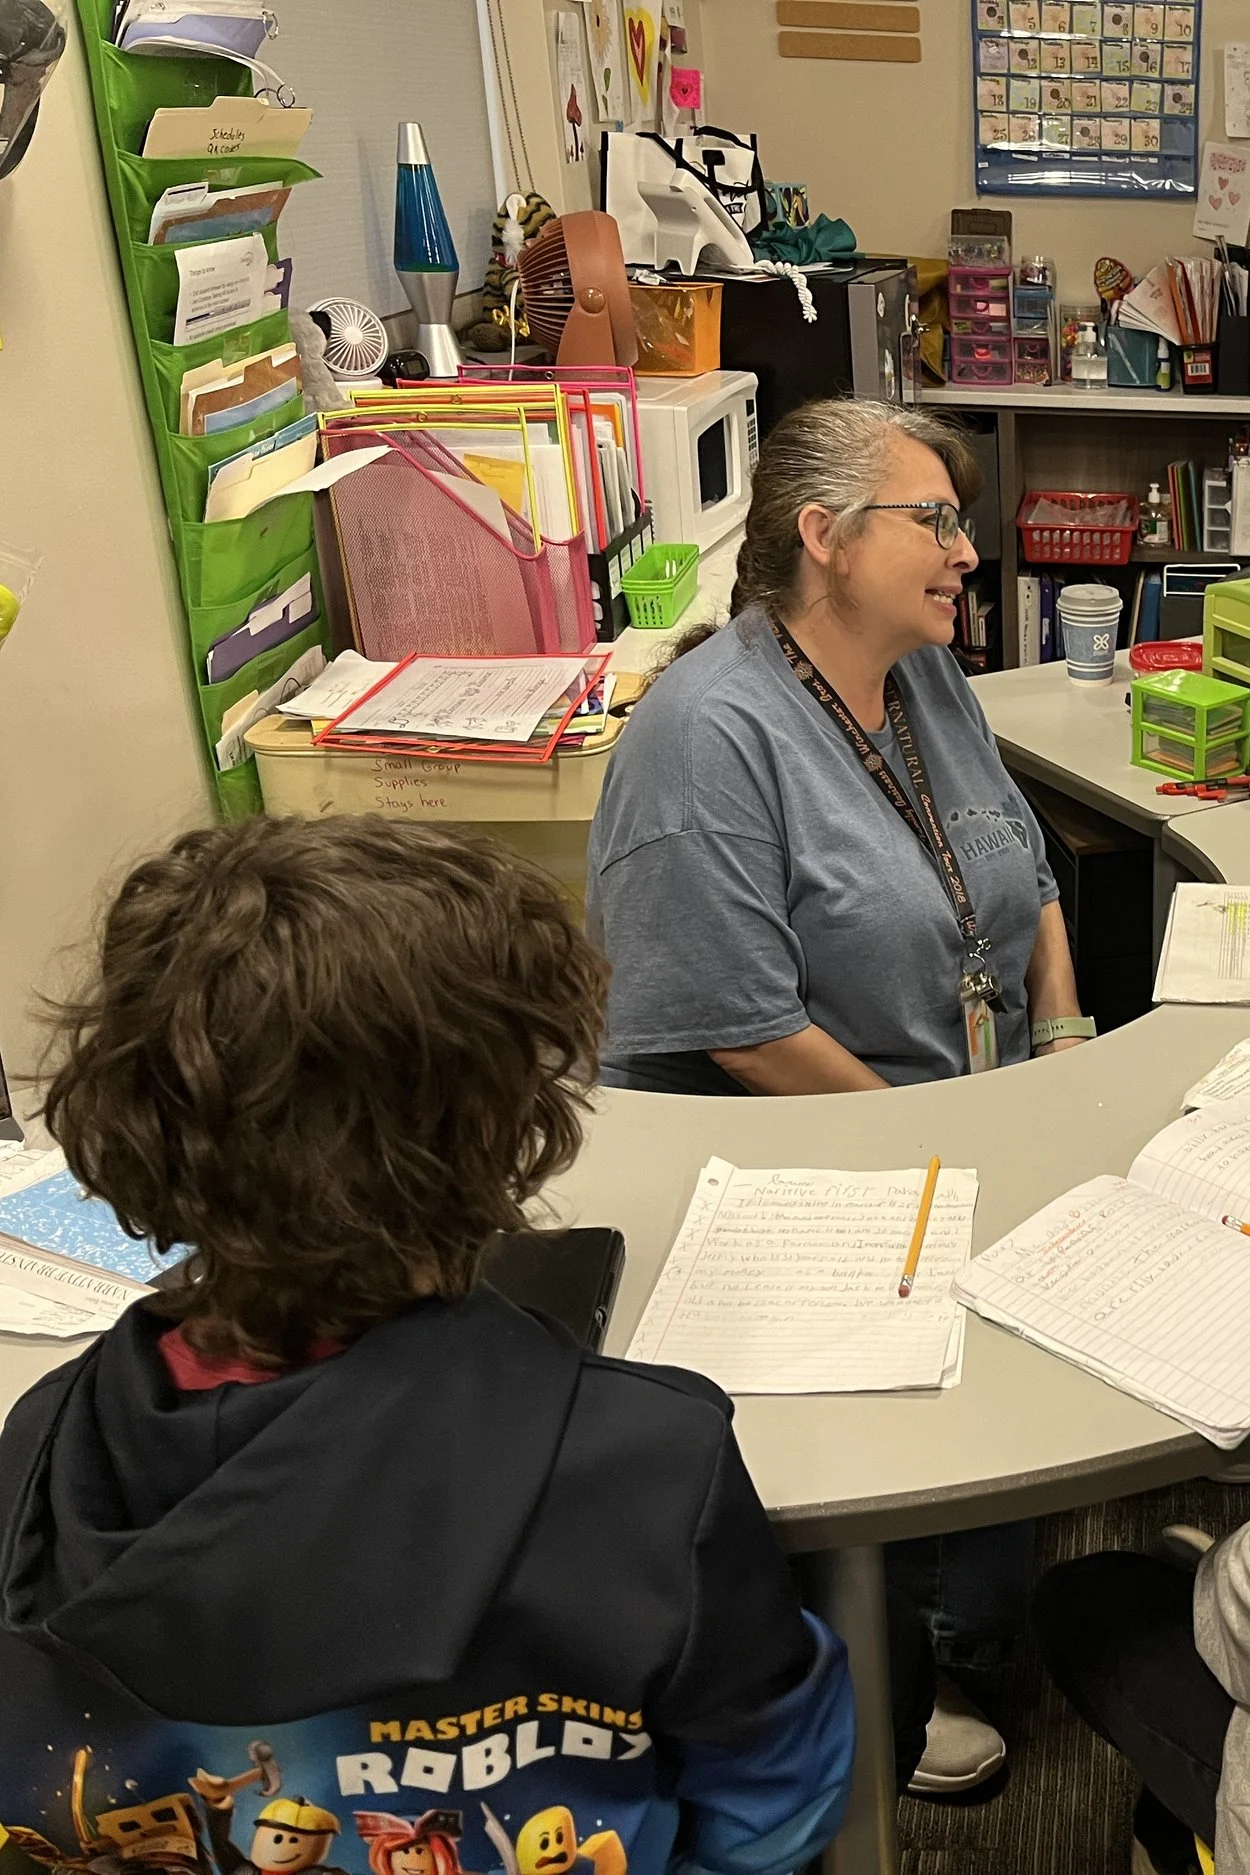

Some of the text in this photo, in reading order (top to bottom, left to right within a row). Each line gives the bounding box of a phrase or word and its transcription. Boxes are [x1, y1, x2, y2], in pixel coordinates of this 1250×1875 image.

[1028, 17, 1036, 30] 5
[1058, 21, 1067, 33] 6
[1090, 21, 1097, 33] 7
[1122, 23, 1129, 36] 8
[1151, 23, 1159, 35] 9
[1176, 22, 1192, 37] 10
[1027, 55, 1192, 73] 12 13 14 15 16 17
[992, 94, 1004, 107] 18
[1024, 96, 1037, 110] 19
[1057, 98, 1071, 110] 20
[1086, 95, 1098, 107] 21
[1115, 96, 1129, 109] 22
[209, 128, 245, 141] Schedules
[993, 128, 1007, 141] 25
[1114, 134, 1128, 146] 29
[1144, 134, 1159, 147] 30
[831, 702, 870, 756] Winchester
[371, 759, 461, 774] Small Group
[374, 777, 428, 790] Supplies
[375, 794, 447, 812] Stays here
[920, 792, 967, 904] Convention Tour 2018
[960, 827, 1016, 861] HAWAII
[54, 1271, 133, 1301] NARRATIVE
[370, 1693, 642, 1743] MASTER SKINS
